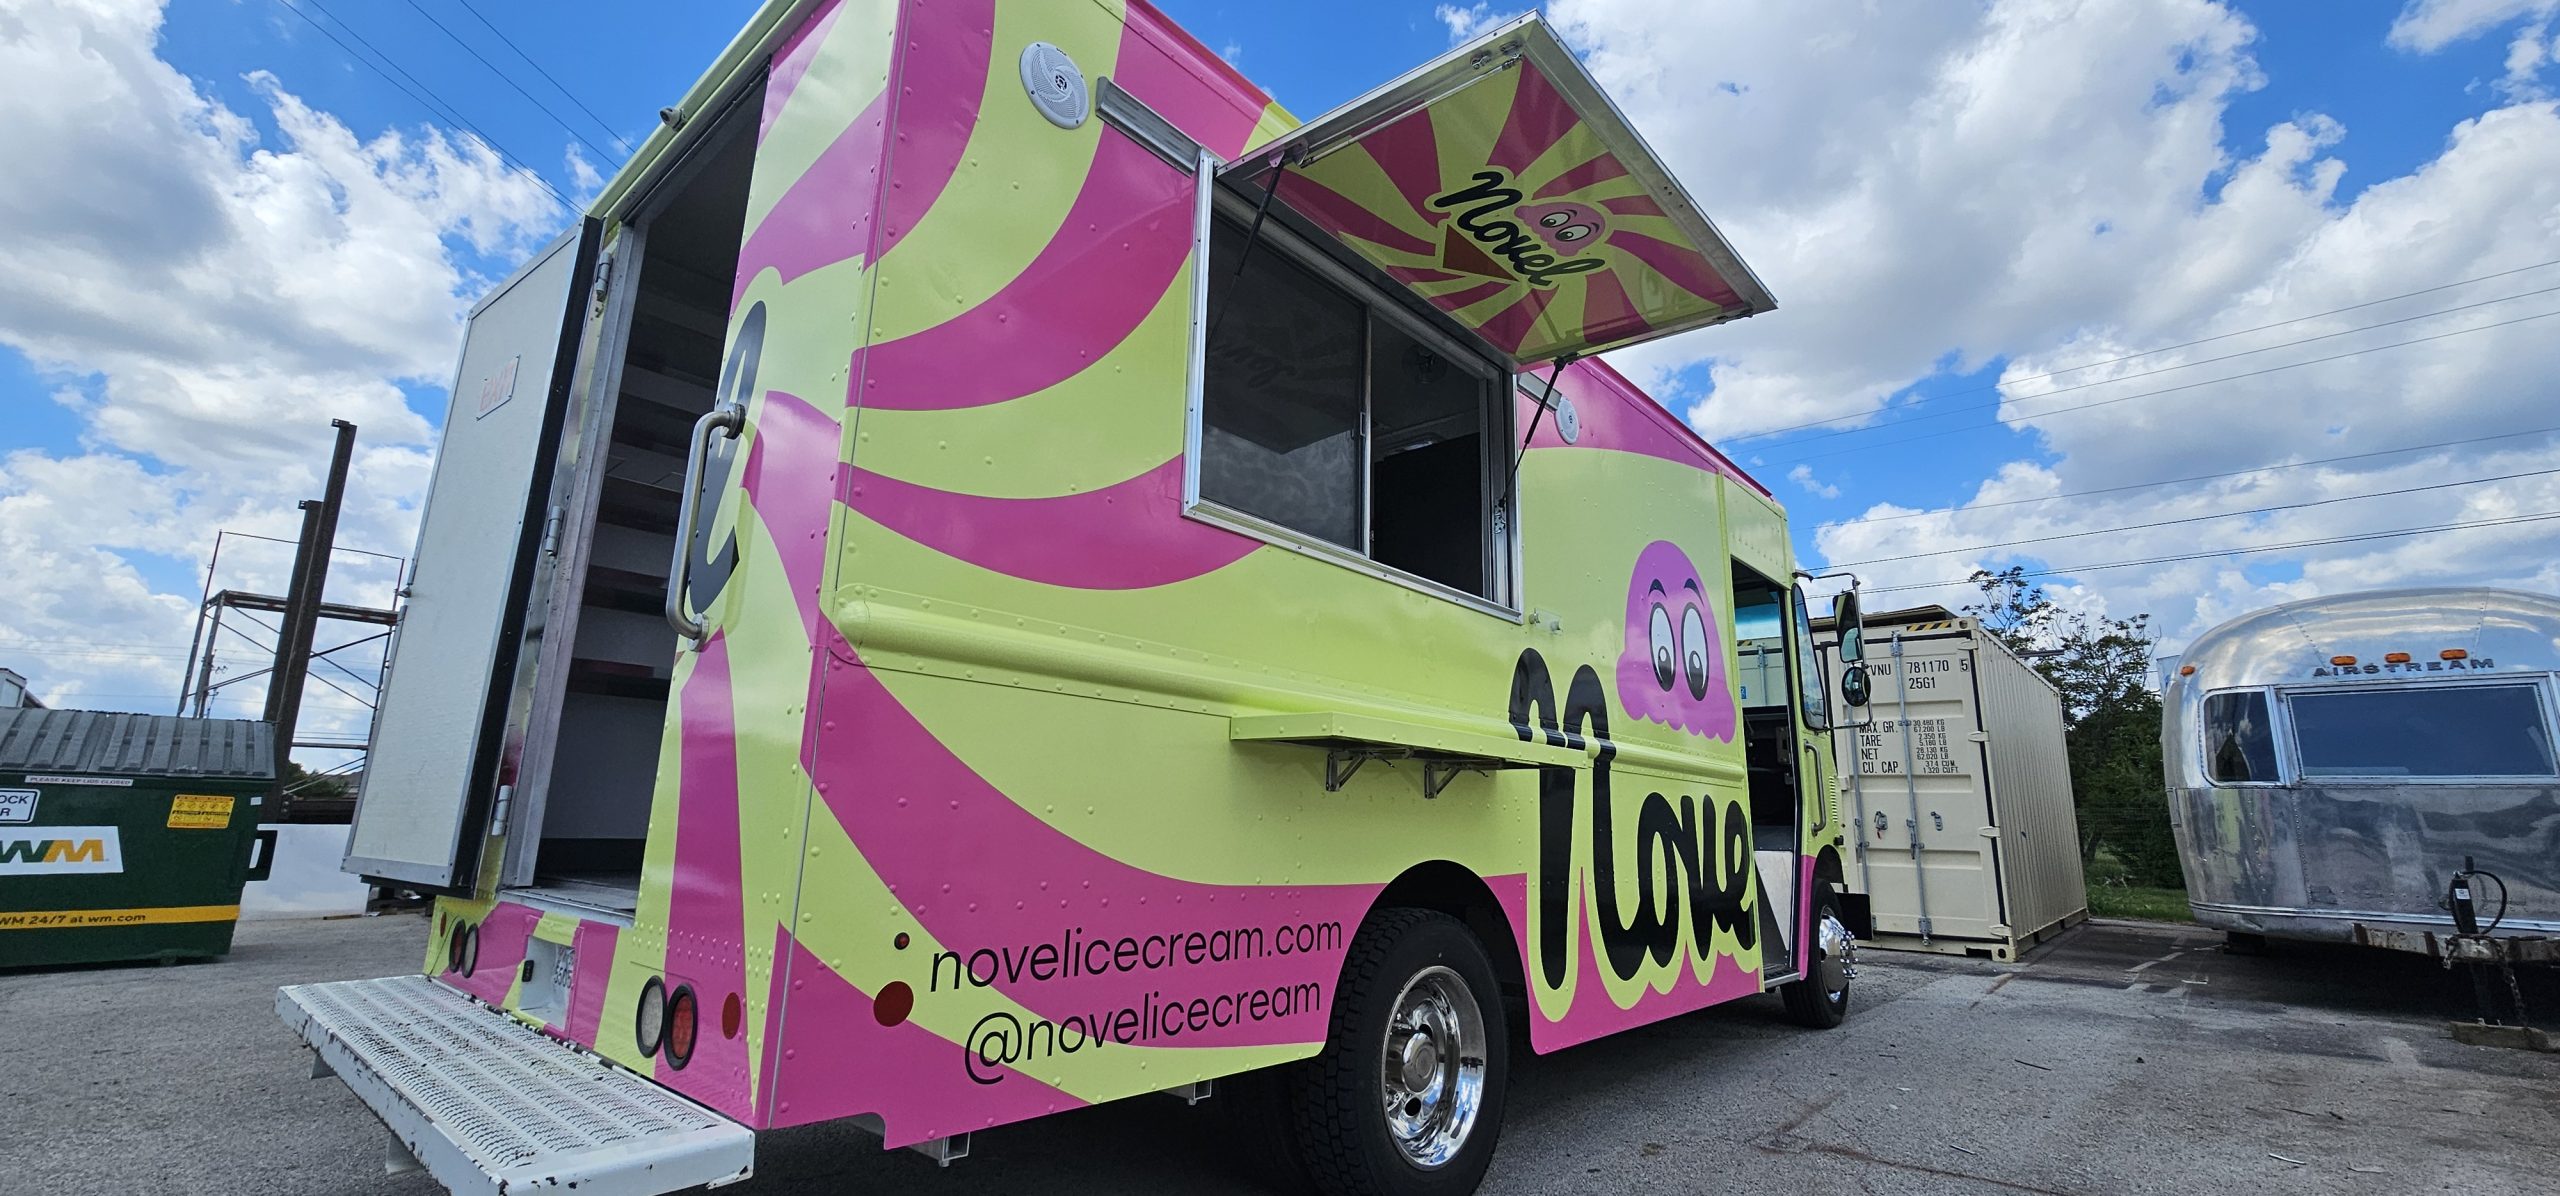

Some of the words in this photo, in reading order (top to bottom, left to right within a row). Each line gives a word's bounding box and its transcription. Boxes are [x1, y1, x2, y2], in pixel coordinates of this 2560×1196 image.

[1866, 663, 1891, 676] VNU
[1906, 660, 1949, 674] 781170
[1960, 659, 1968, 671] 5
[2313, 658, 2495, 677] AIRSTREAM
[1908, 677, 1936, 689] 25G1
[1860, 735, 1882, 747] TARE
[1861, 748, 1878, 760] NET
[29, 915, 66, 925] 24/7
[70, 915, 83, 924] at
[88, 914, 146, 923] wm.com
[930, 920, 1343, 992] novelicecream.com
[964, 981, 1321, 1085] @novelicecream
